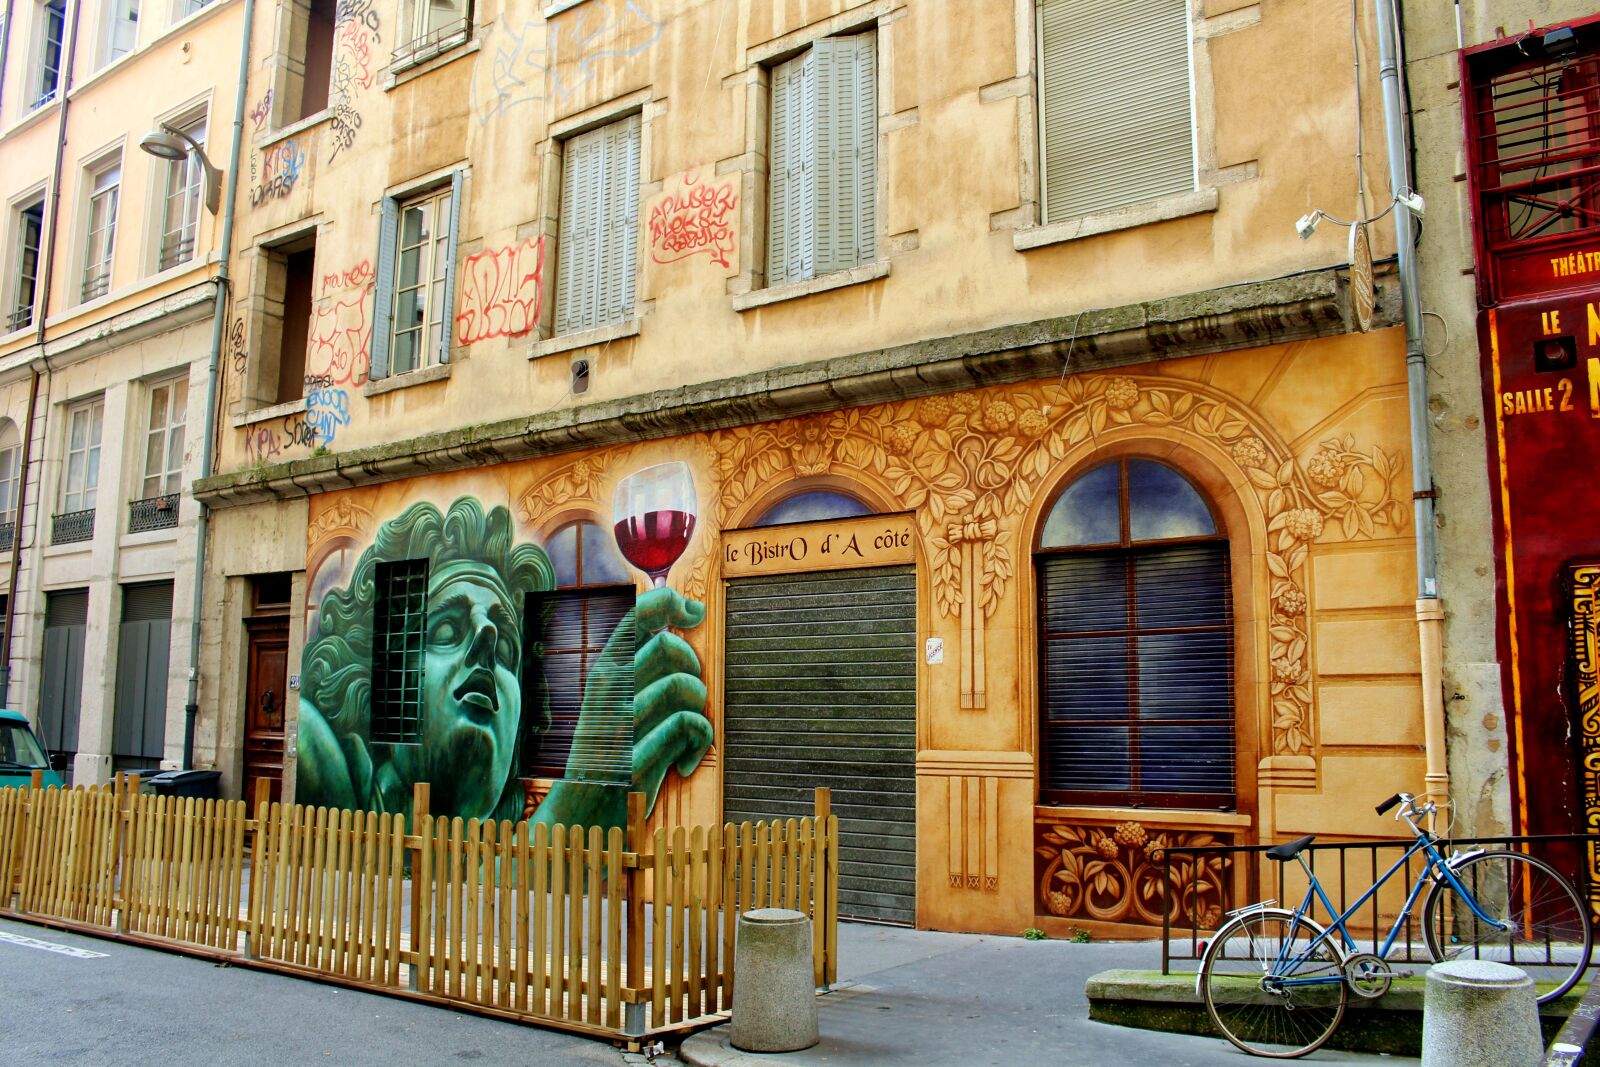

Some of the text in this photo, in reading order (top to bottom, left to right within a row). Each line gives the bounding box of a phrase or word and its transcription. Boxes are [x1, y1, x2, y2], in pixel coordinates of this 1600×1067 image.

[1541, 310, 1561, 335] LE
[1503, 387, 1554, 415] SALLE
[1557, 378, 1575, 412] 2
[726, 543, 739, 562] le
[874, 527, 910, 549] côté
